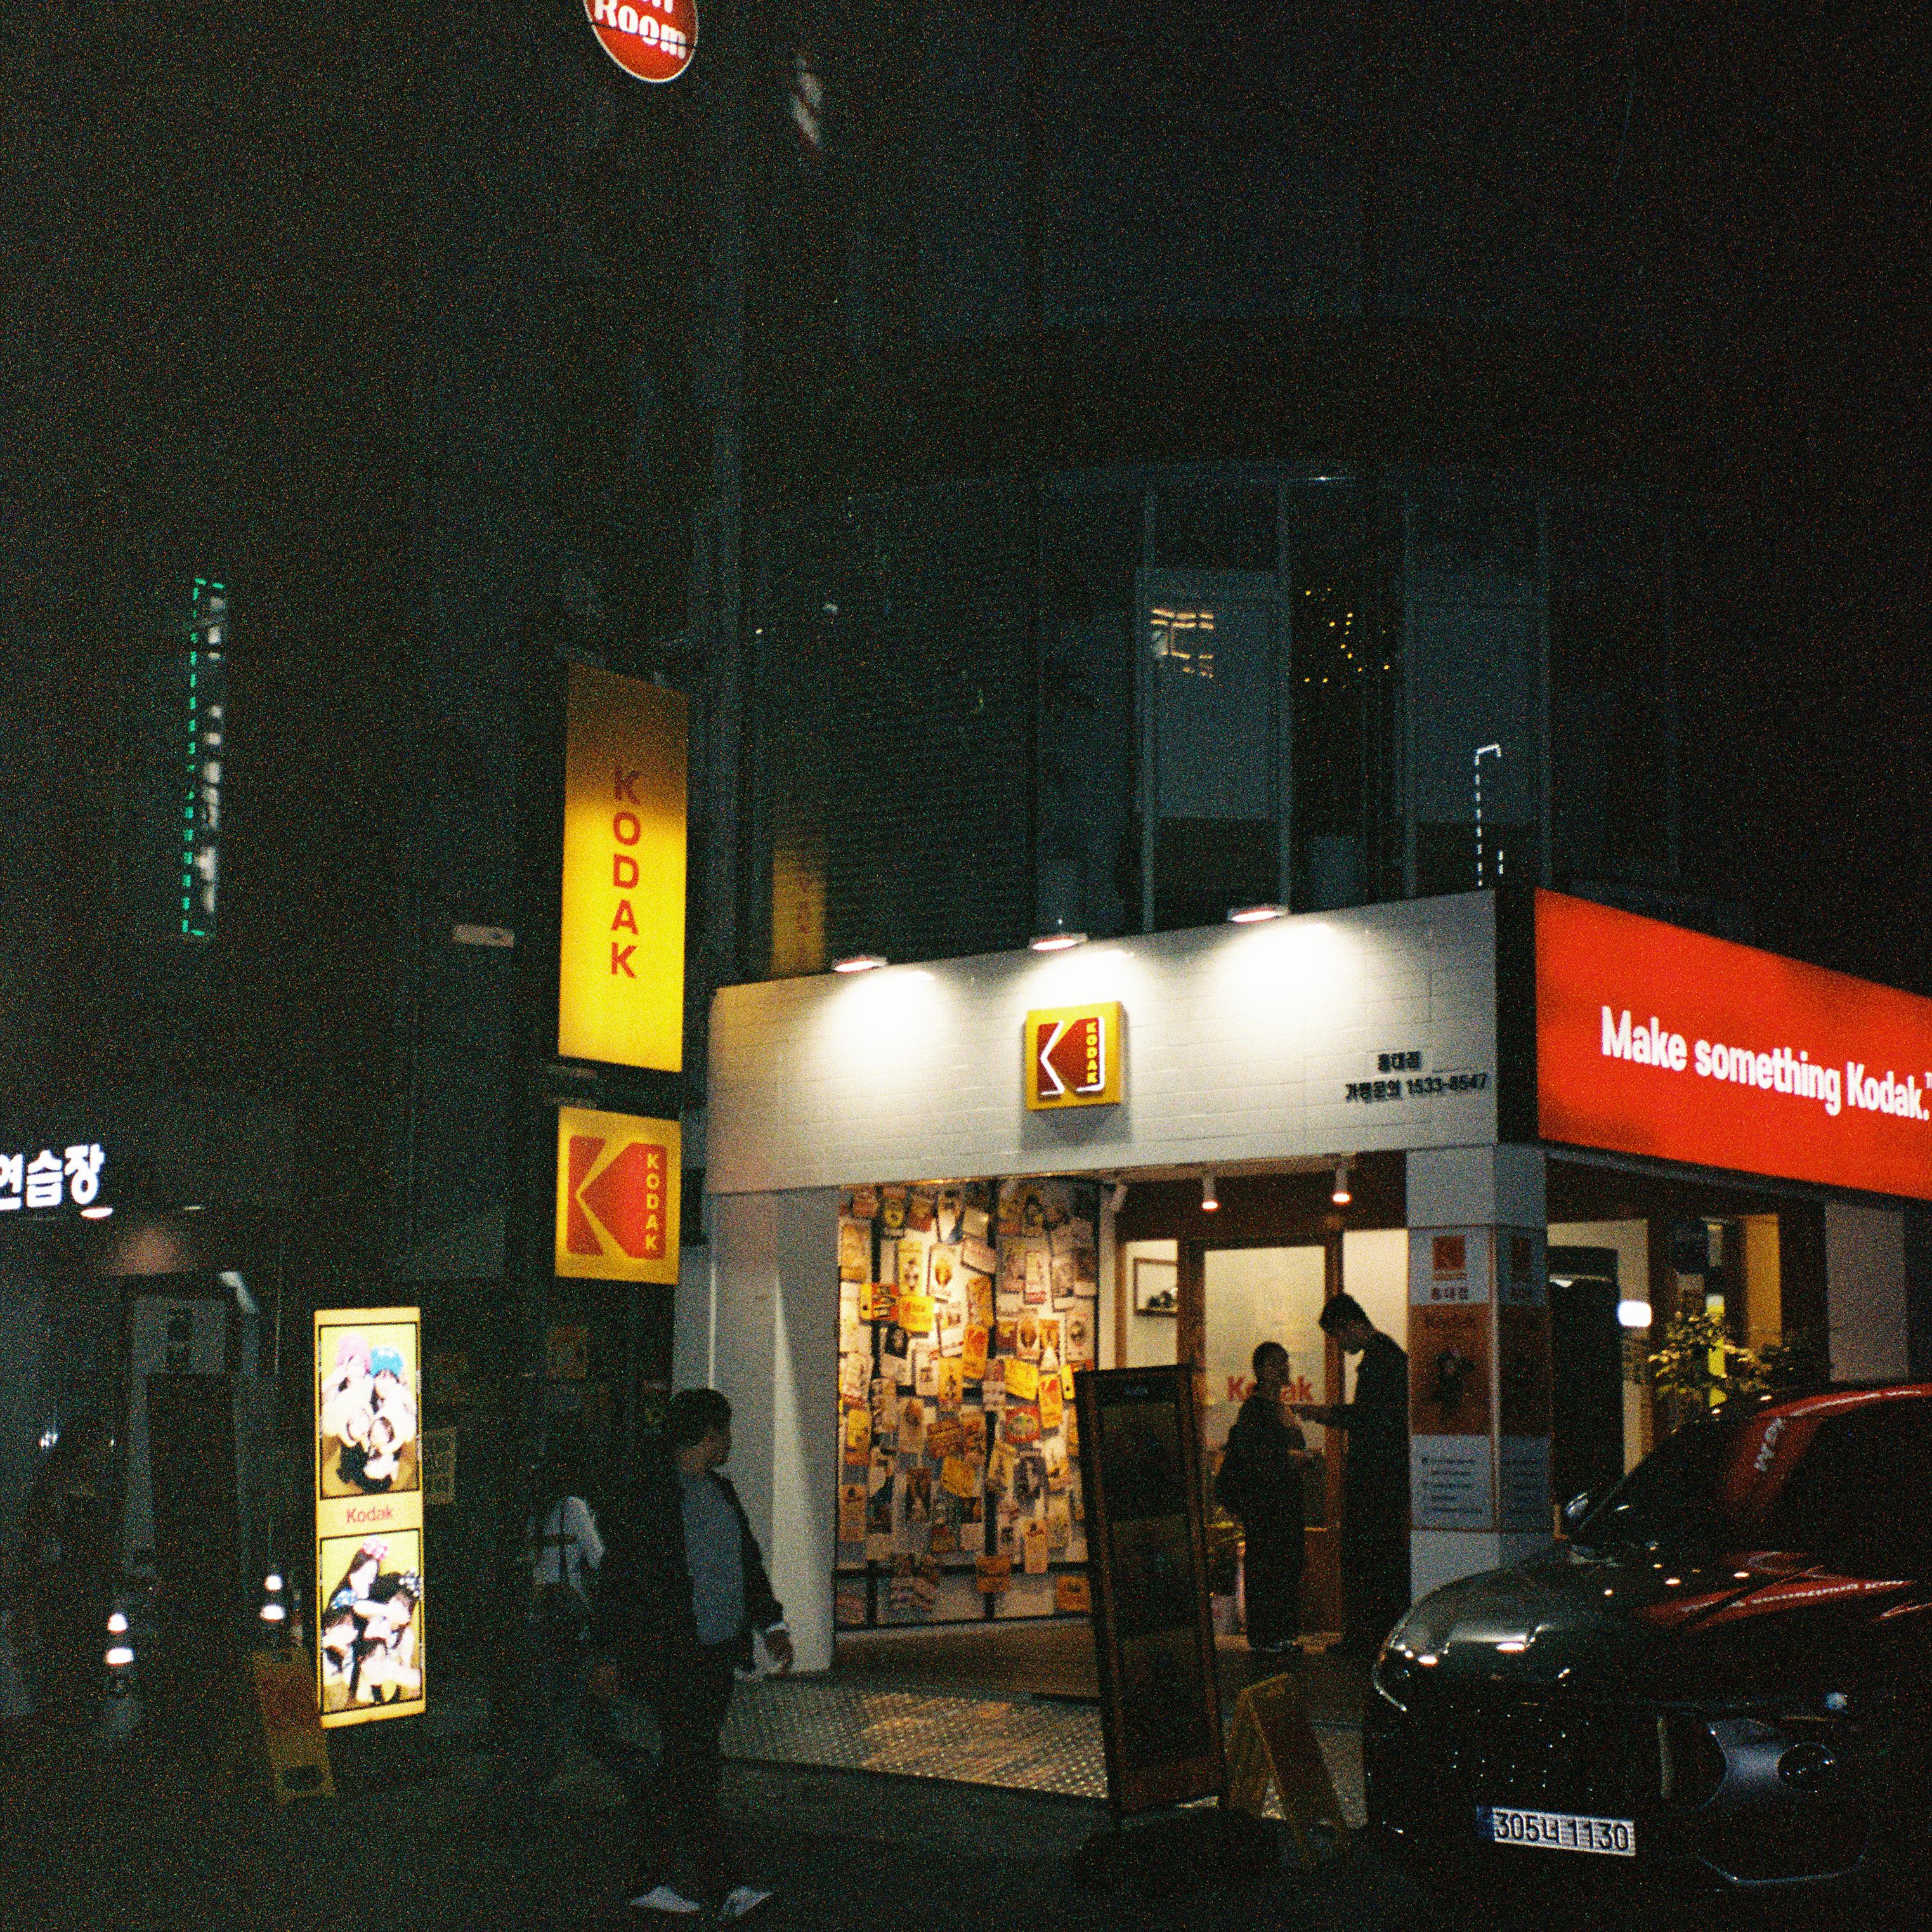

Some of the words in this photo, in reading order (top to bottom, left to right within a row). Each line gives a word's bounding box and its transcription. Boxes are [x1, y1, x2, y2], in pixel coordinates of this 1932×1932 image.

[594, 0, 686, 59] Room
[610, 769, 642, 979] KODAK
[1085, 1021, 1098, 1084] KODAK
[1602, 1006, 1687, 1072] Make
[1695, 1040, 1841, 1116] something
[645, 1152, 661, 1253] KODAK
[346, 1504, 393, 1524] Kodak
